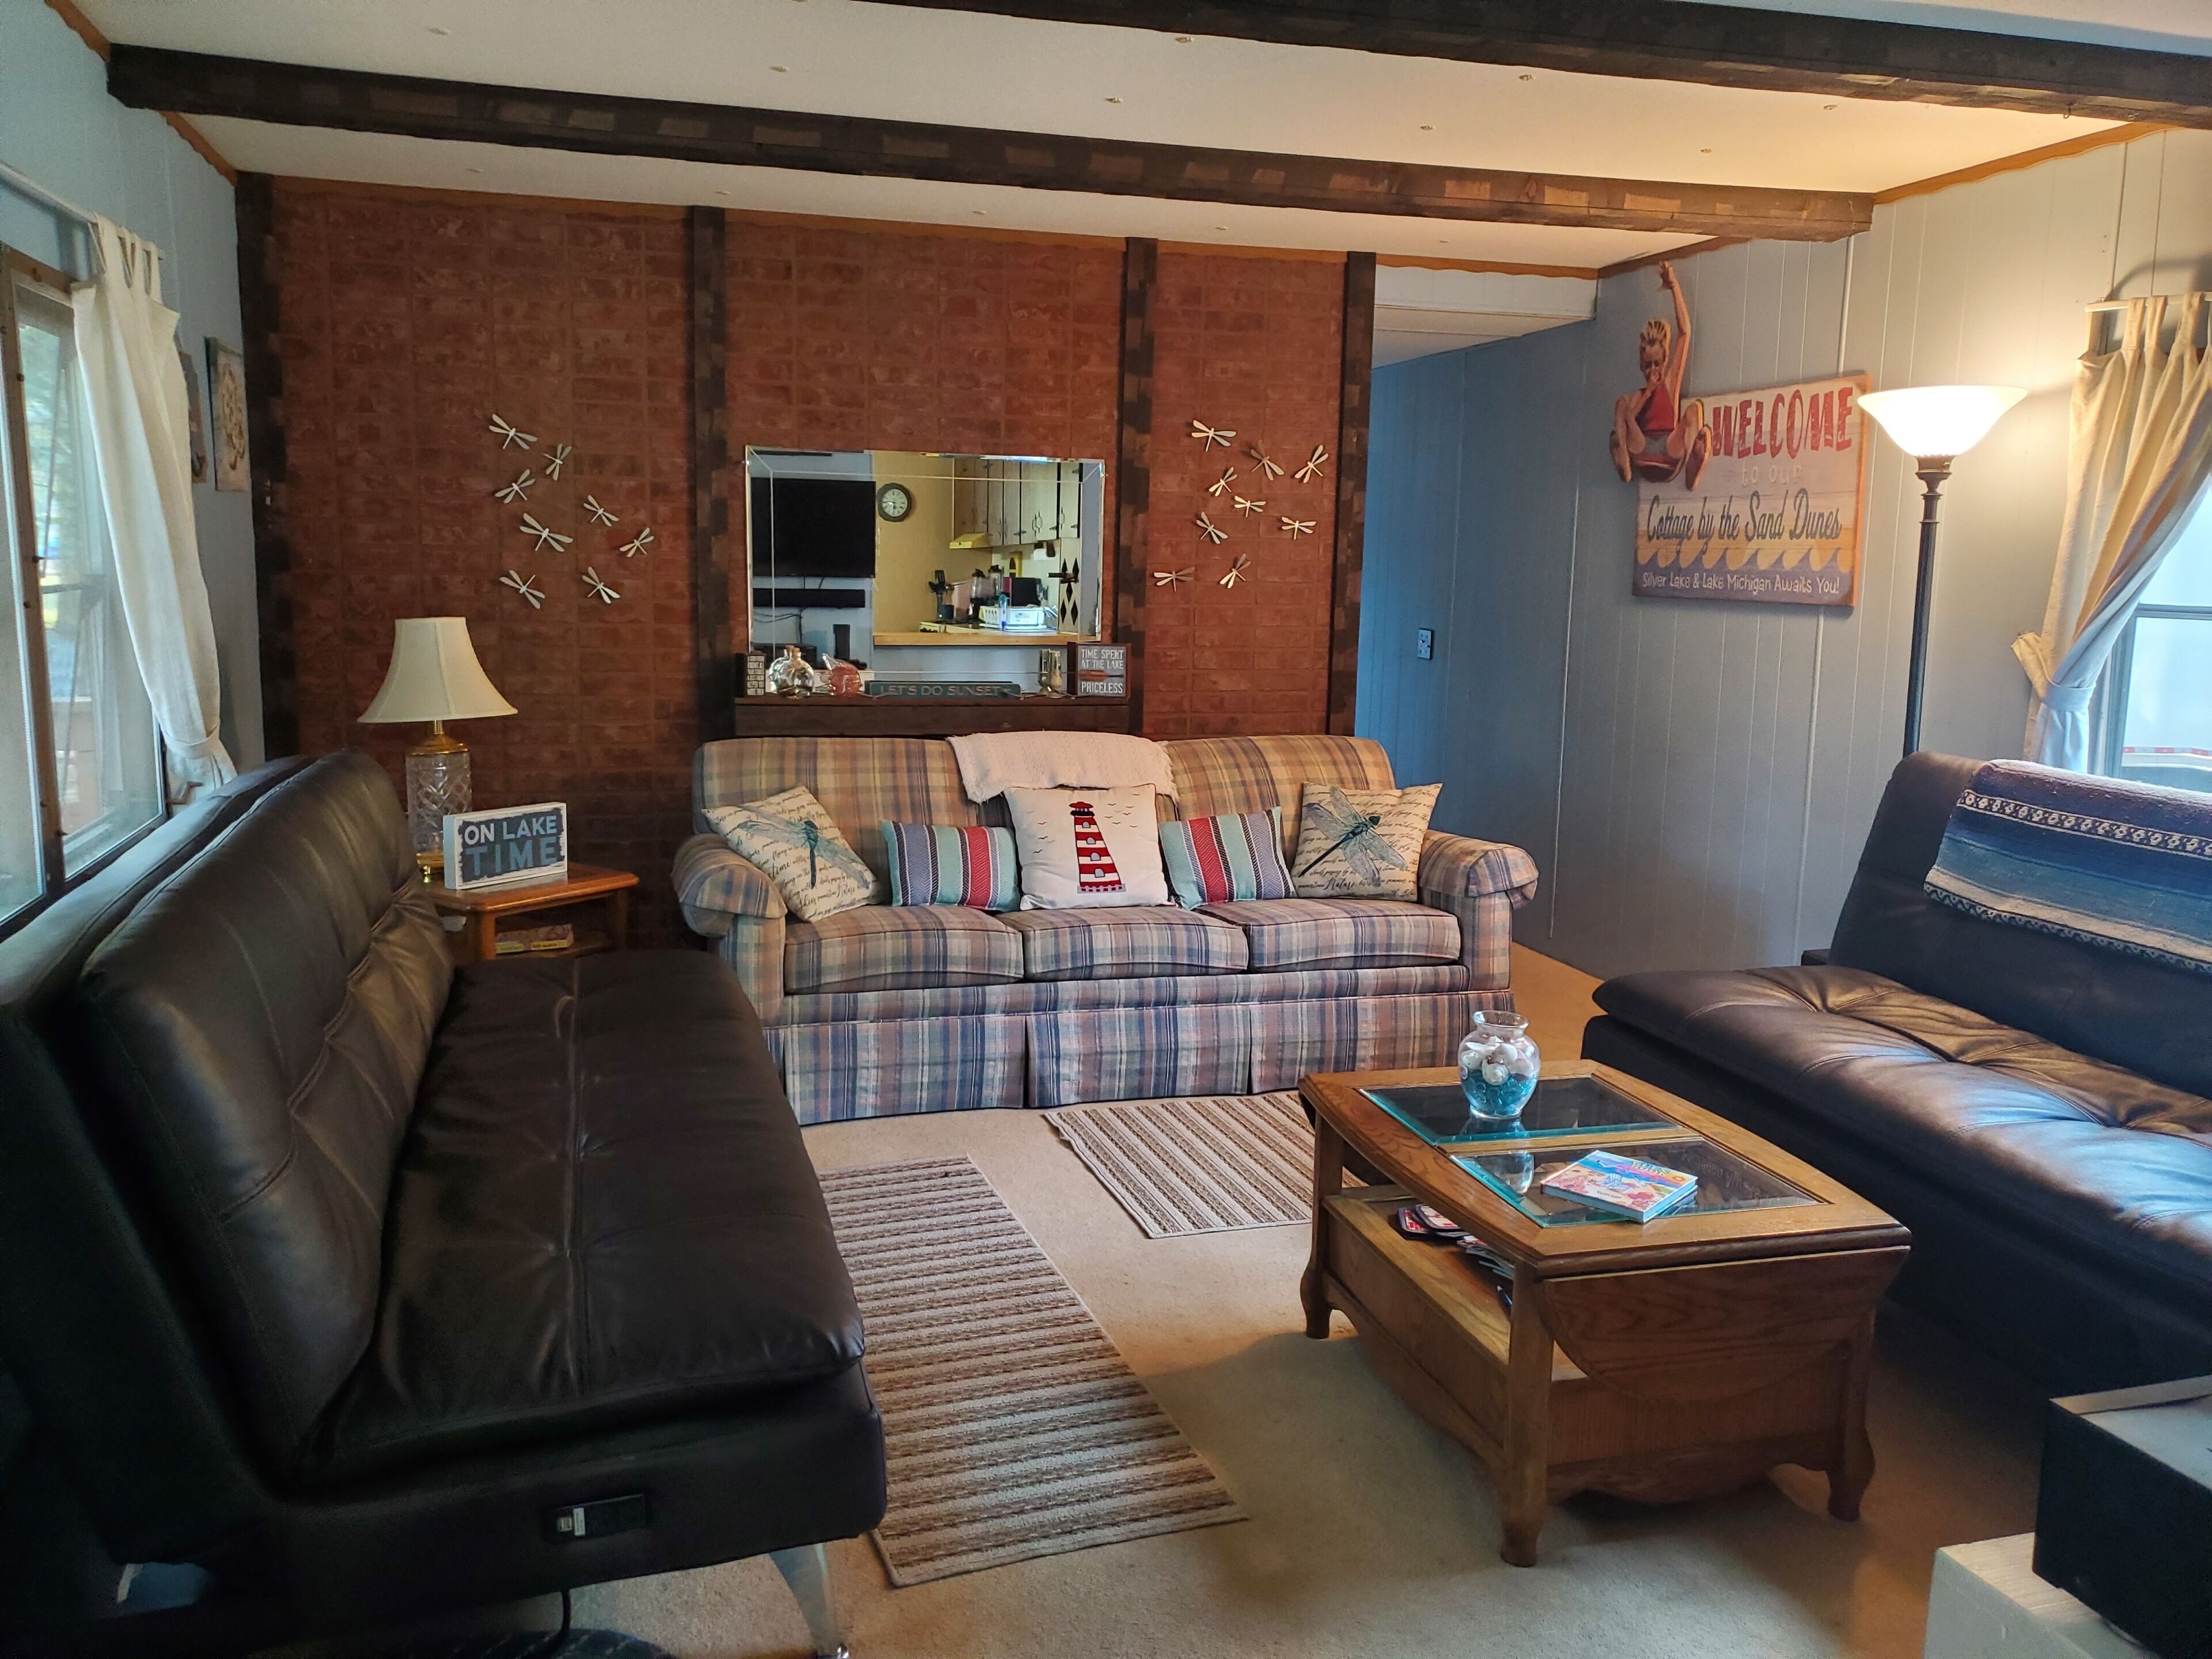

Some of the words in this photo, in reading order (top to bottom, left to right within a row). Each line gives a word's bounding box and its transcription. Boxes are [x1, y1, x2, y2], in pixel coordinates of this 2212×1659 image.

[1712, 387, 1853, 459] WELCOME
[1742, 460, 1759, 487] to
[1769, 463, 1802, 484] our
[1647, 494, 1694, 555] Cottage
[1698, 496, 1715, 555] by
[1718, 495, 1740, 540] the
[1745, 490, 1789, 542] Sand
[1789, 488, 1842, 540] Dunes
[1643, 571, 1666, 588] Silver
[1670, 571, 1690, 588] Lake
[1692, 573, 1700, 589] &
[1702, 572, 1724, 589] Lake
[1728, 574, 1771, 596] Michigan
[1774, 574, 1812, 593] Awaits
[1817, 576, 1840, 594] You!
[1081, 649, 1098, 659] TIME
[1101, 649, 1124, 660] SPENT
[1081, 660, 1090, 668] AT
[1092, 660, 1105, 668] THE
[1107, 660, 1124, 669] LAKE
[922, 685, 944, 696] DO
[1081, 681, 1123, 694] PRICELESS
[464, 823, 495, 846] ON
[502, 815, 557, 840] LAKE
[465, 836, 558, 876] TIME
